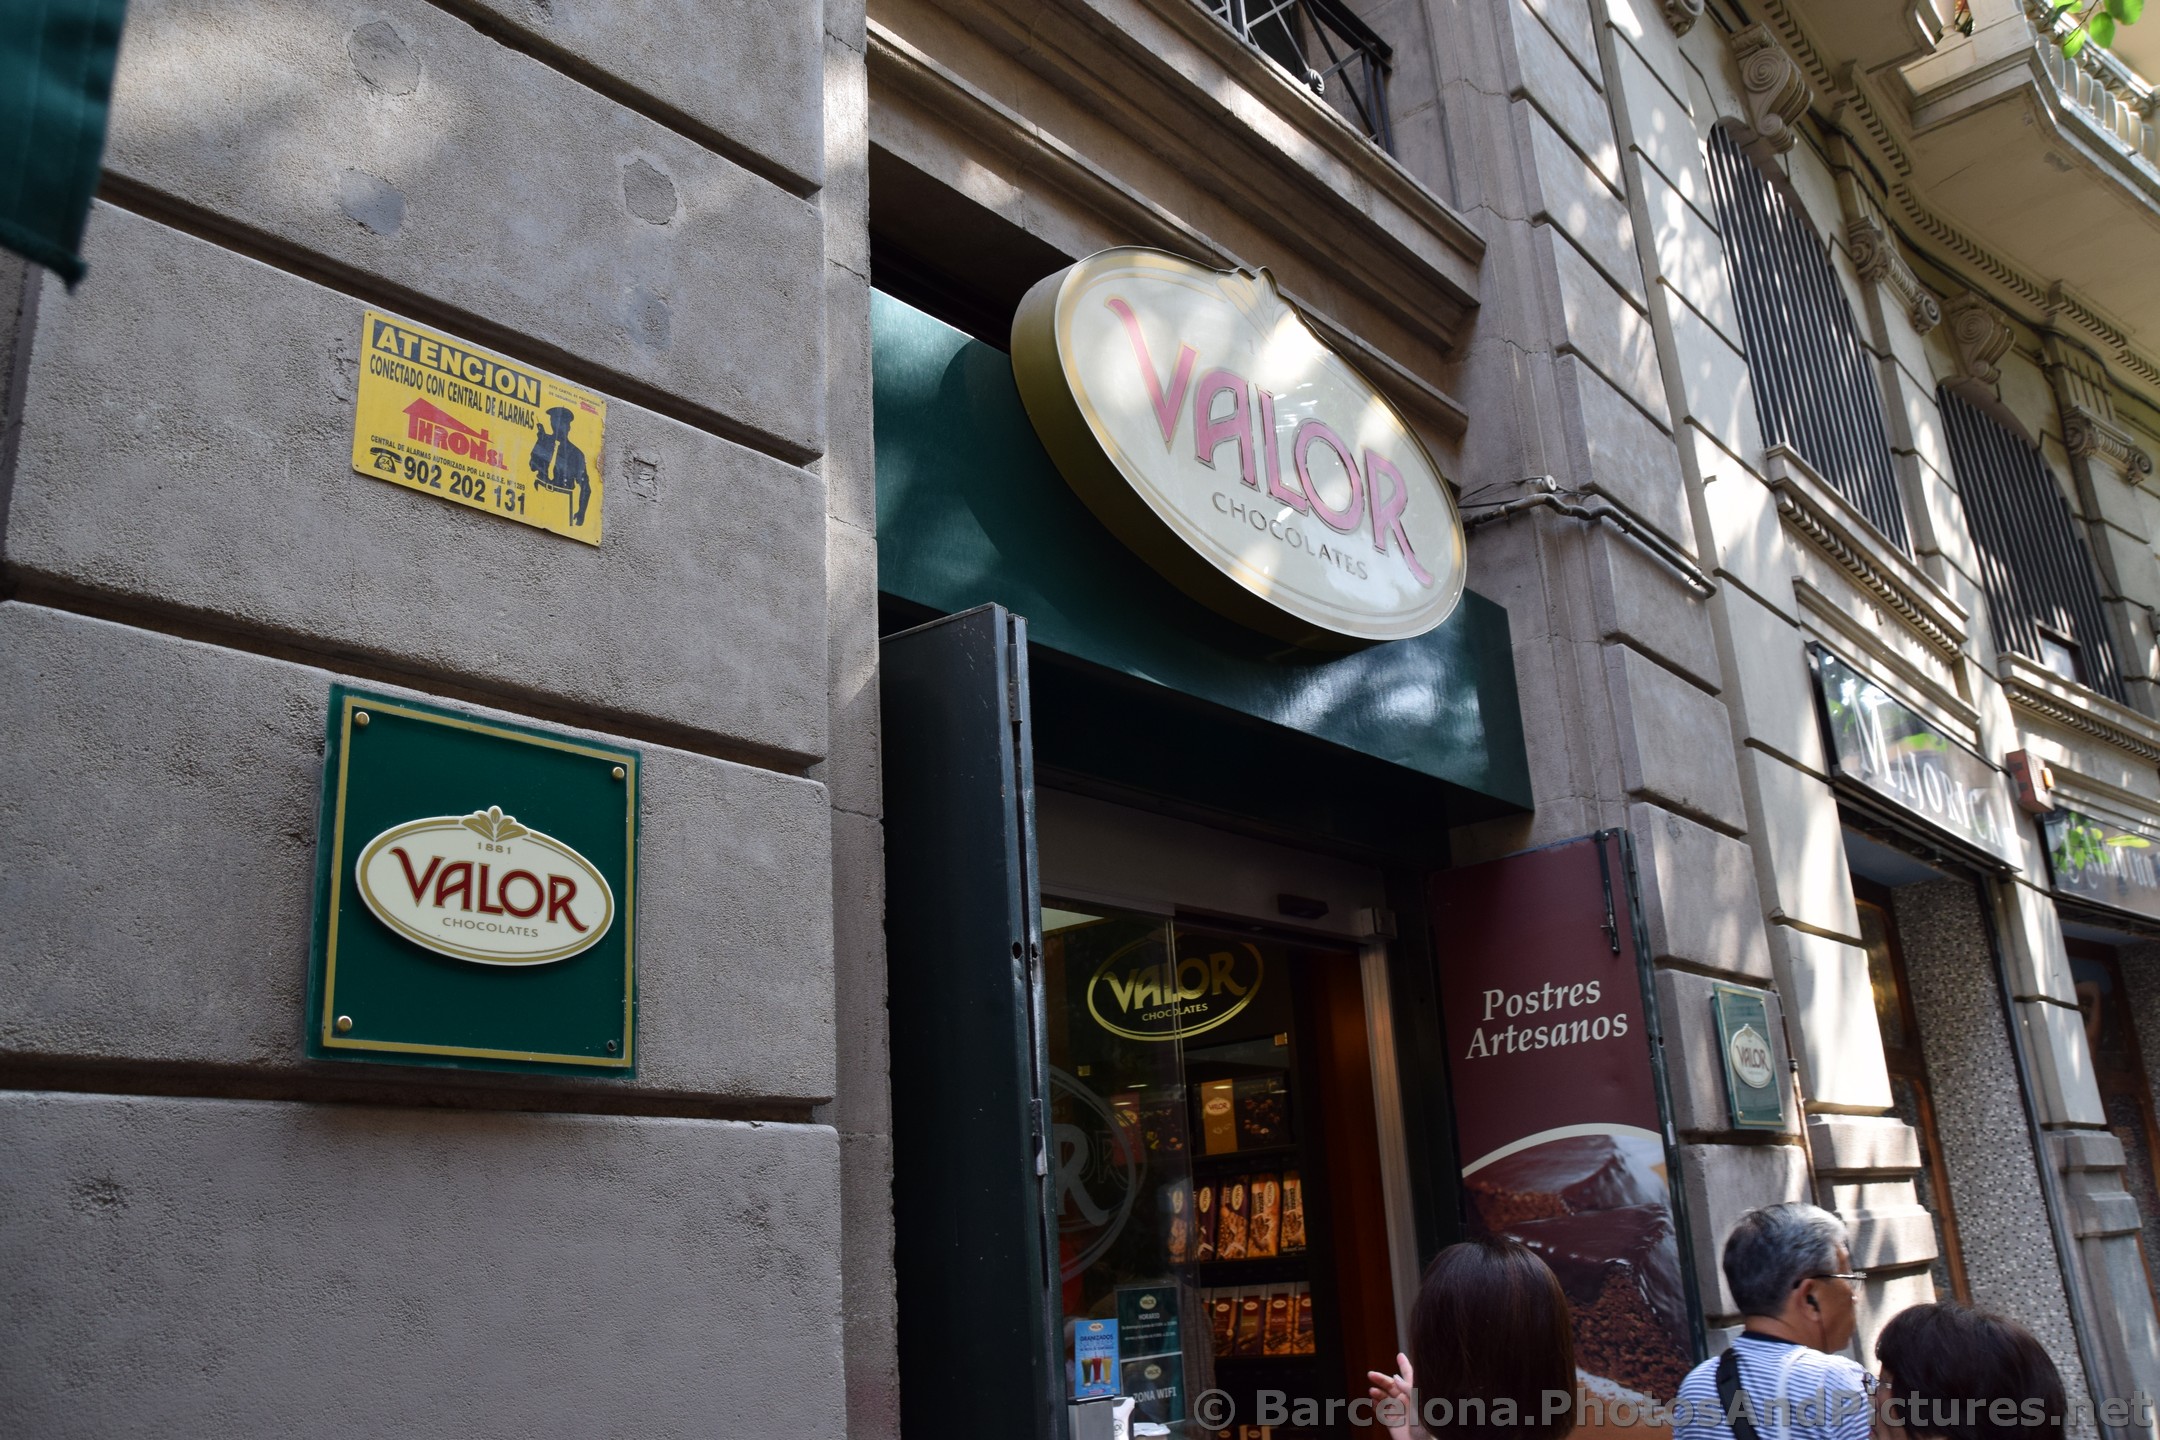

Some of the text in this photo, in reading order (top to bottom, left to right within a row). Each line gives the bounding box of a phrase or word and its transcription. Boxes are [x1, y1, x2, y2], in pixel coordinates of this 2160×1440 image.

[376, 325, 538, 405] ATENCION
[370, 354, 535, 430] CONECTADO CON CENTRAL DE ALARMAS
[370, 435, 396, 448] CENTRAL
[397, 443, 405, 451] DE
[406, 447, 431, 460] ALARMAS
[433, 455, 465, 471] AUTORIZADA
[467, 466, 477, 477] POR
[479, 470, 485, 478] LA
[1104, 296, 1434, 588] VALOR
[404, 456, 525, 515] 902 202 131
[1212, 491, 1369, 581] CHOCOLATES
[1844, 680, 2003, 848] MAJORICA
[477, 842, 512, 855] 1881
[388, 846, 590, 934] VALOR
[442, 917, 539, 938] CHOCOLATES
[1102, 952, 1248, 1014] VALOR
[1482, 980, 1601, 1021] Postres
[1141, 1002, 1209, 1022] CHOCOLATES
[1465, 1013, 1628, 1060] Artesanos
[1735, 1045, 1770, 1072] VALOR
[1133, 1386, 1177, 1403] ZONA WIFI
